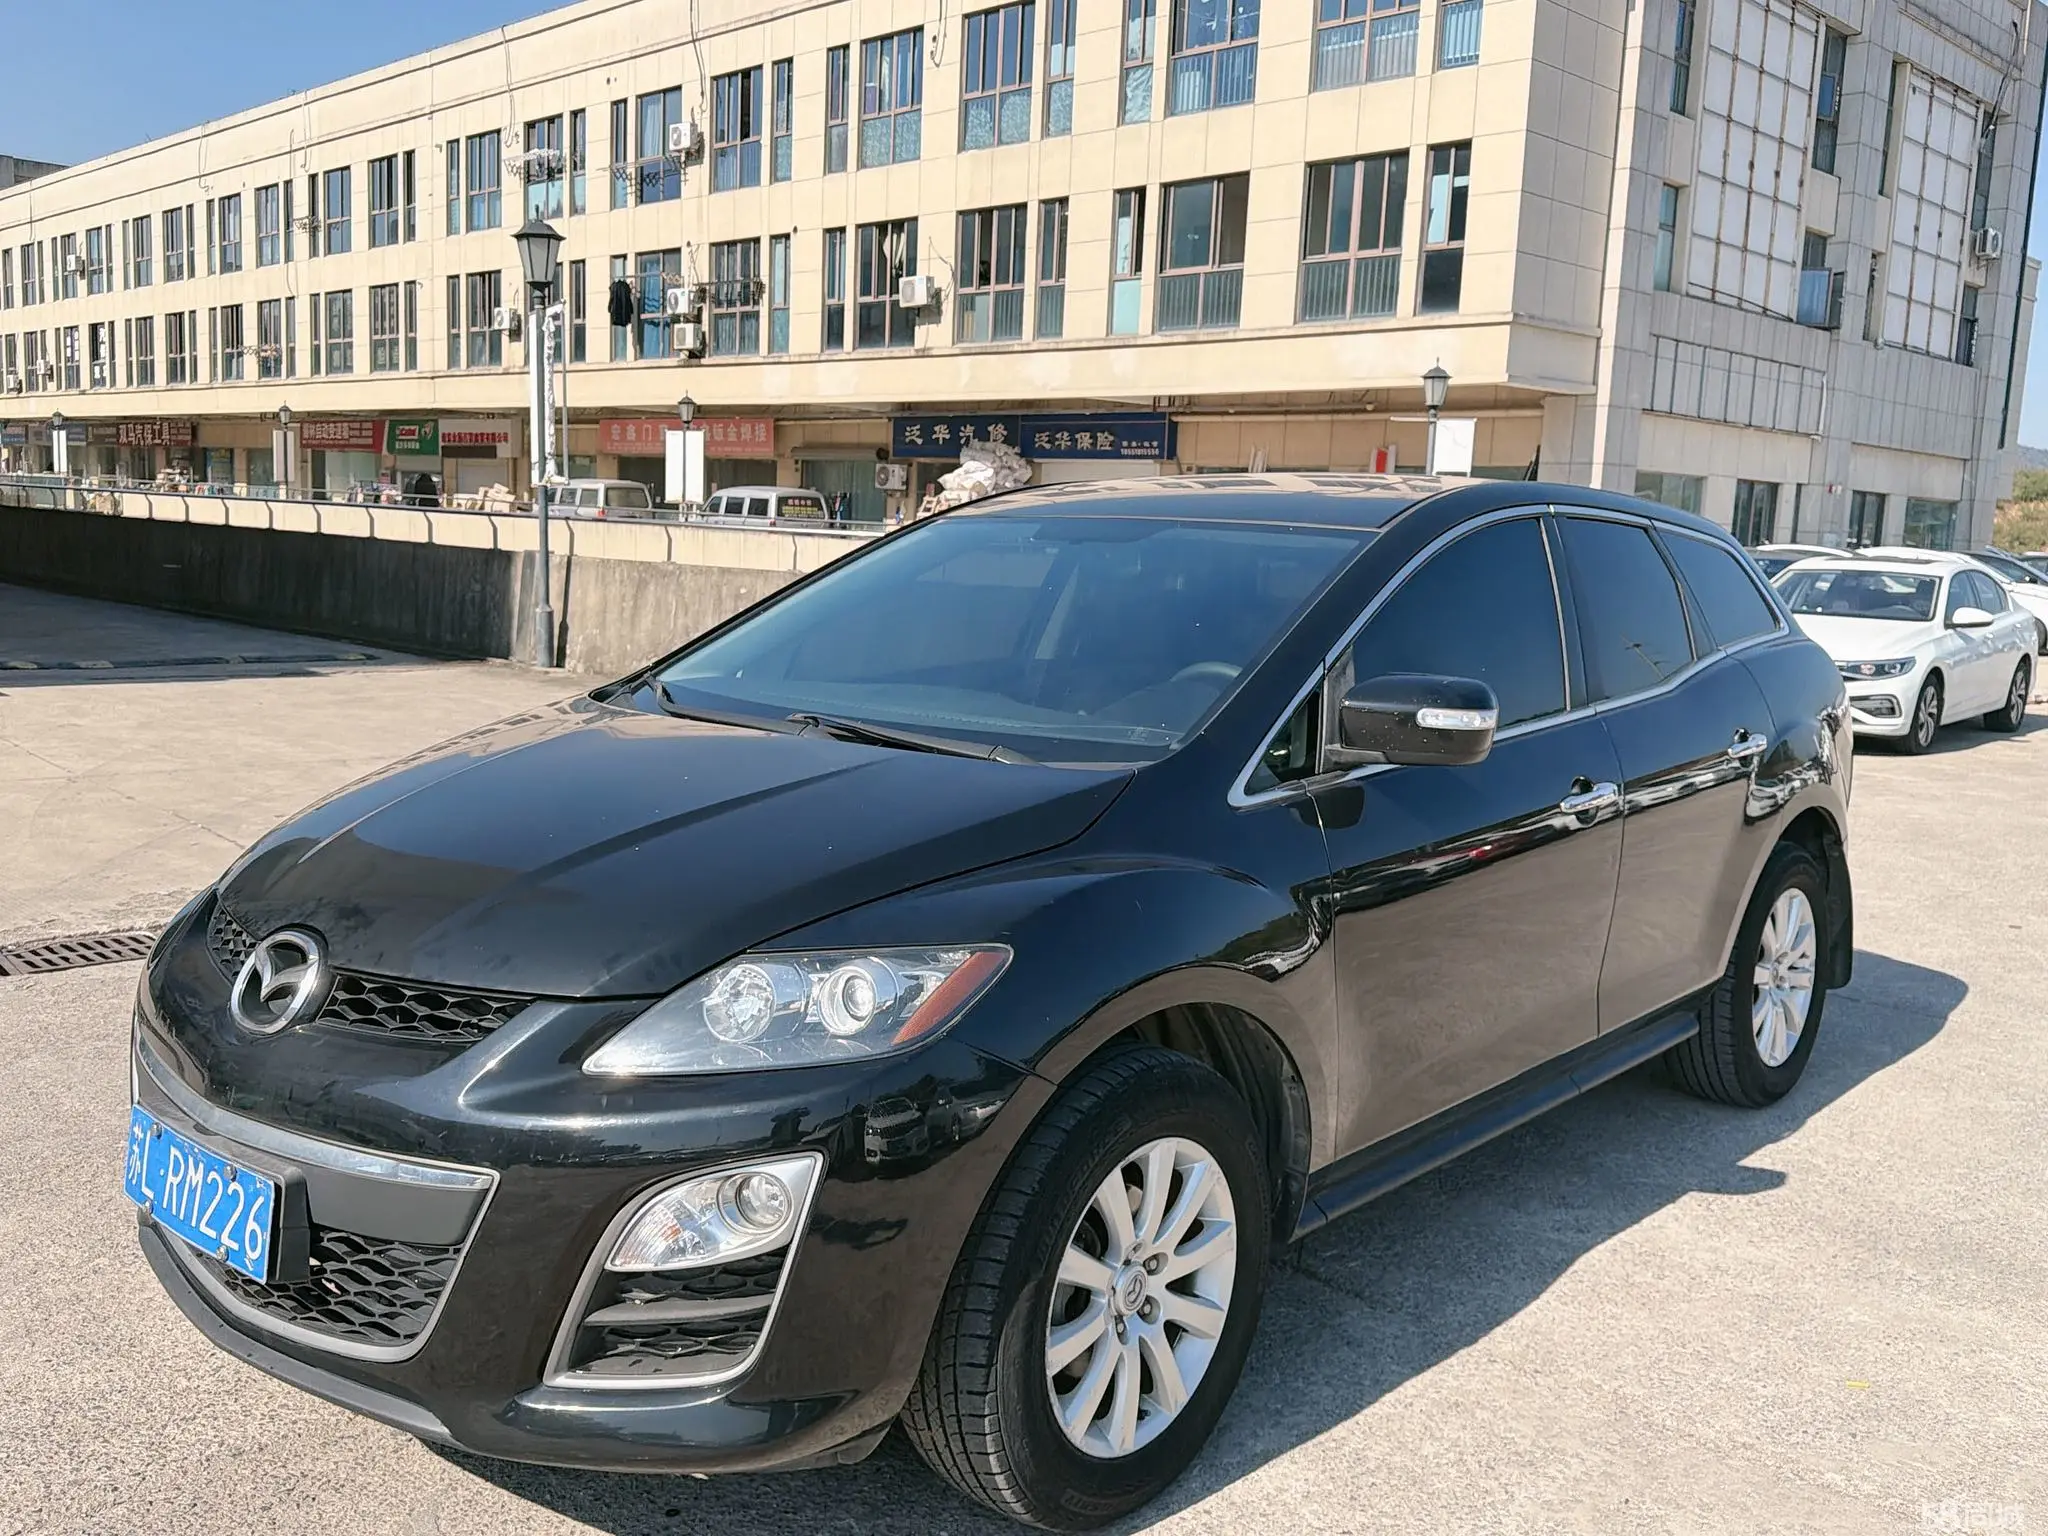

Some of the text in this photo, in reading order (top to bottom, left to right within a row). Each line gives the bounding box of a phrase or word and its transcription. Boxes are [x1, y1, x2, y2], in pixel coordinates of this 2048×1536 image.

[905, 423, 1009, 445] 泛华汽修
[1034, 431, 1115, 451] 泛华保险
